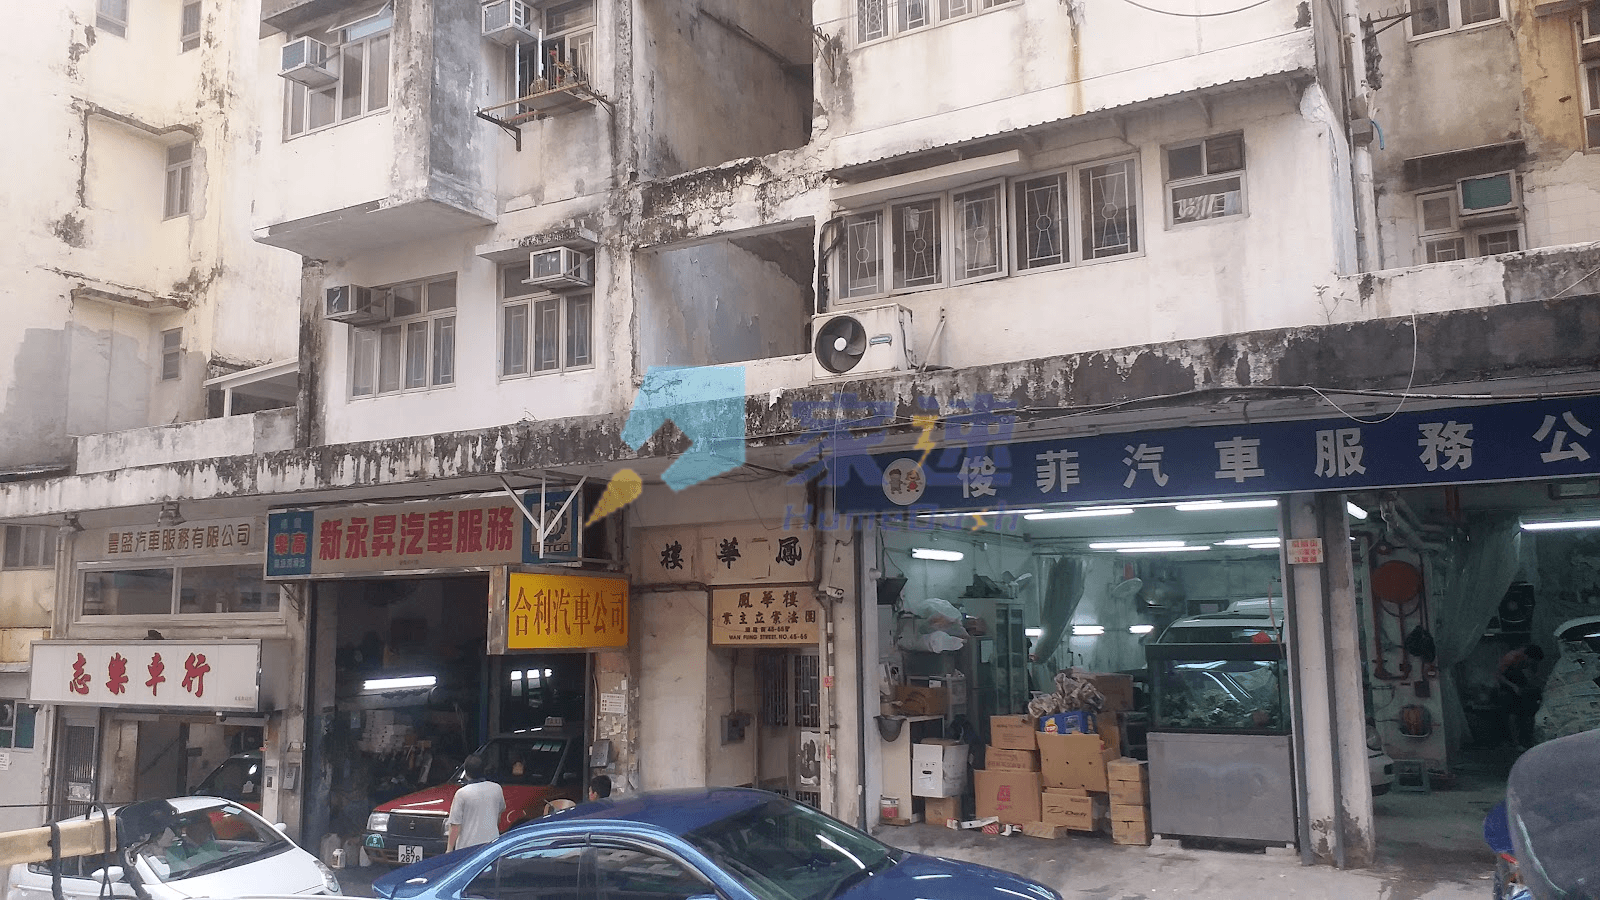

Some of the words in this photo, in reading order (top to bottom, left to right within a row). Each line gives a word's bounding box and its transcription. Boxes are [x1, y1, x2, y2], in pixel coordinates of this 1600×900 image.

[957, 410, 1592, 498] 俊菲汽車服務公
[319, 505, 515, 561] 新永昇汽車服務
[512, 586, 625, 636] 合利汽車公司
[737, 590, 799, 609] 鳳華樓
[405, 845, 416, 855] EK
